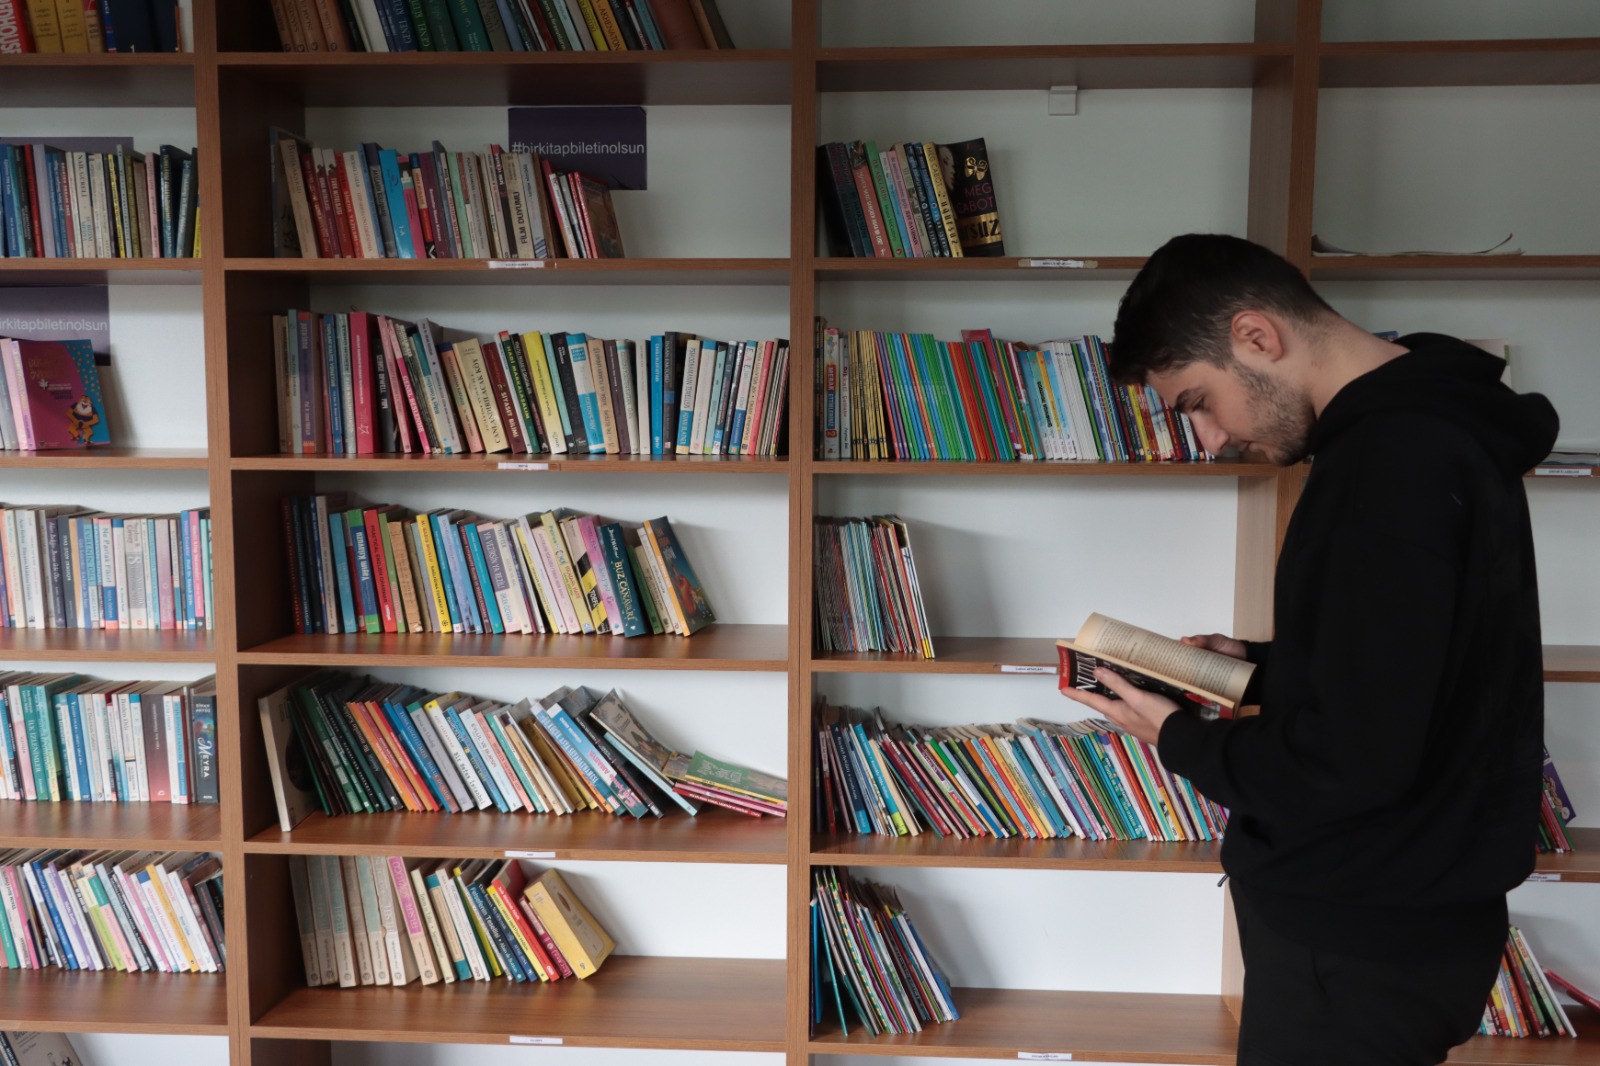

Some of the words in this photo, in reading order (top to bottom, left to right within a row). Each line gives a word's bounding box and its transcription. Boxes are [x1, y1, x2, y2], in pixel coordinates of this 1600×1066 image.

[511, 141, 646, 157] #birkitapbiletinolsun
[964, 182, 992, 198] MEG
[512, 190, 525, 225] DUYUMU
[957, 197, 994, 214] CABOT
[515, 225, 528, 245] FİLM
[402, 374, 414, 397] GENEL
[475, 373, 501, 444] CANLANDIRILACAK
[500, 391, 512, 417] SİYASET
[84, 527, 94, 565] EVRENİN
[485, 539, 500, 564] VEZİRSİN
[614, 560, 625, 579] BUZ
[589, 590, 599, 608] TOEFL
[619, 577, 639, 623] CANAVARI
[29, 731, 41, 774] İZLENİMLER
[197, 736, 214, 779] MEYRA
[471, 887, 488, 917] Felsefenin
[485, 915, 500, 939] Tesellisi
